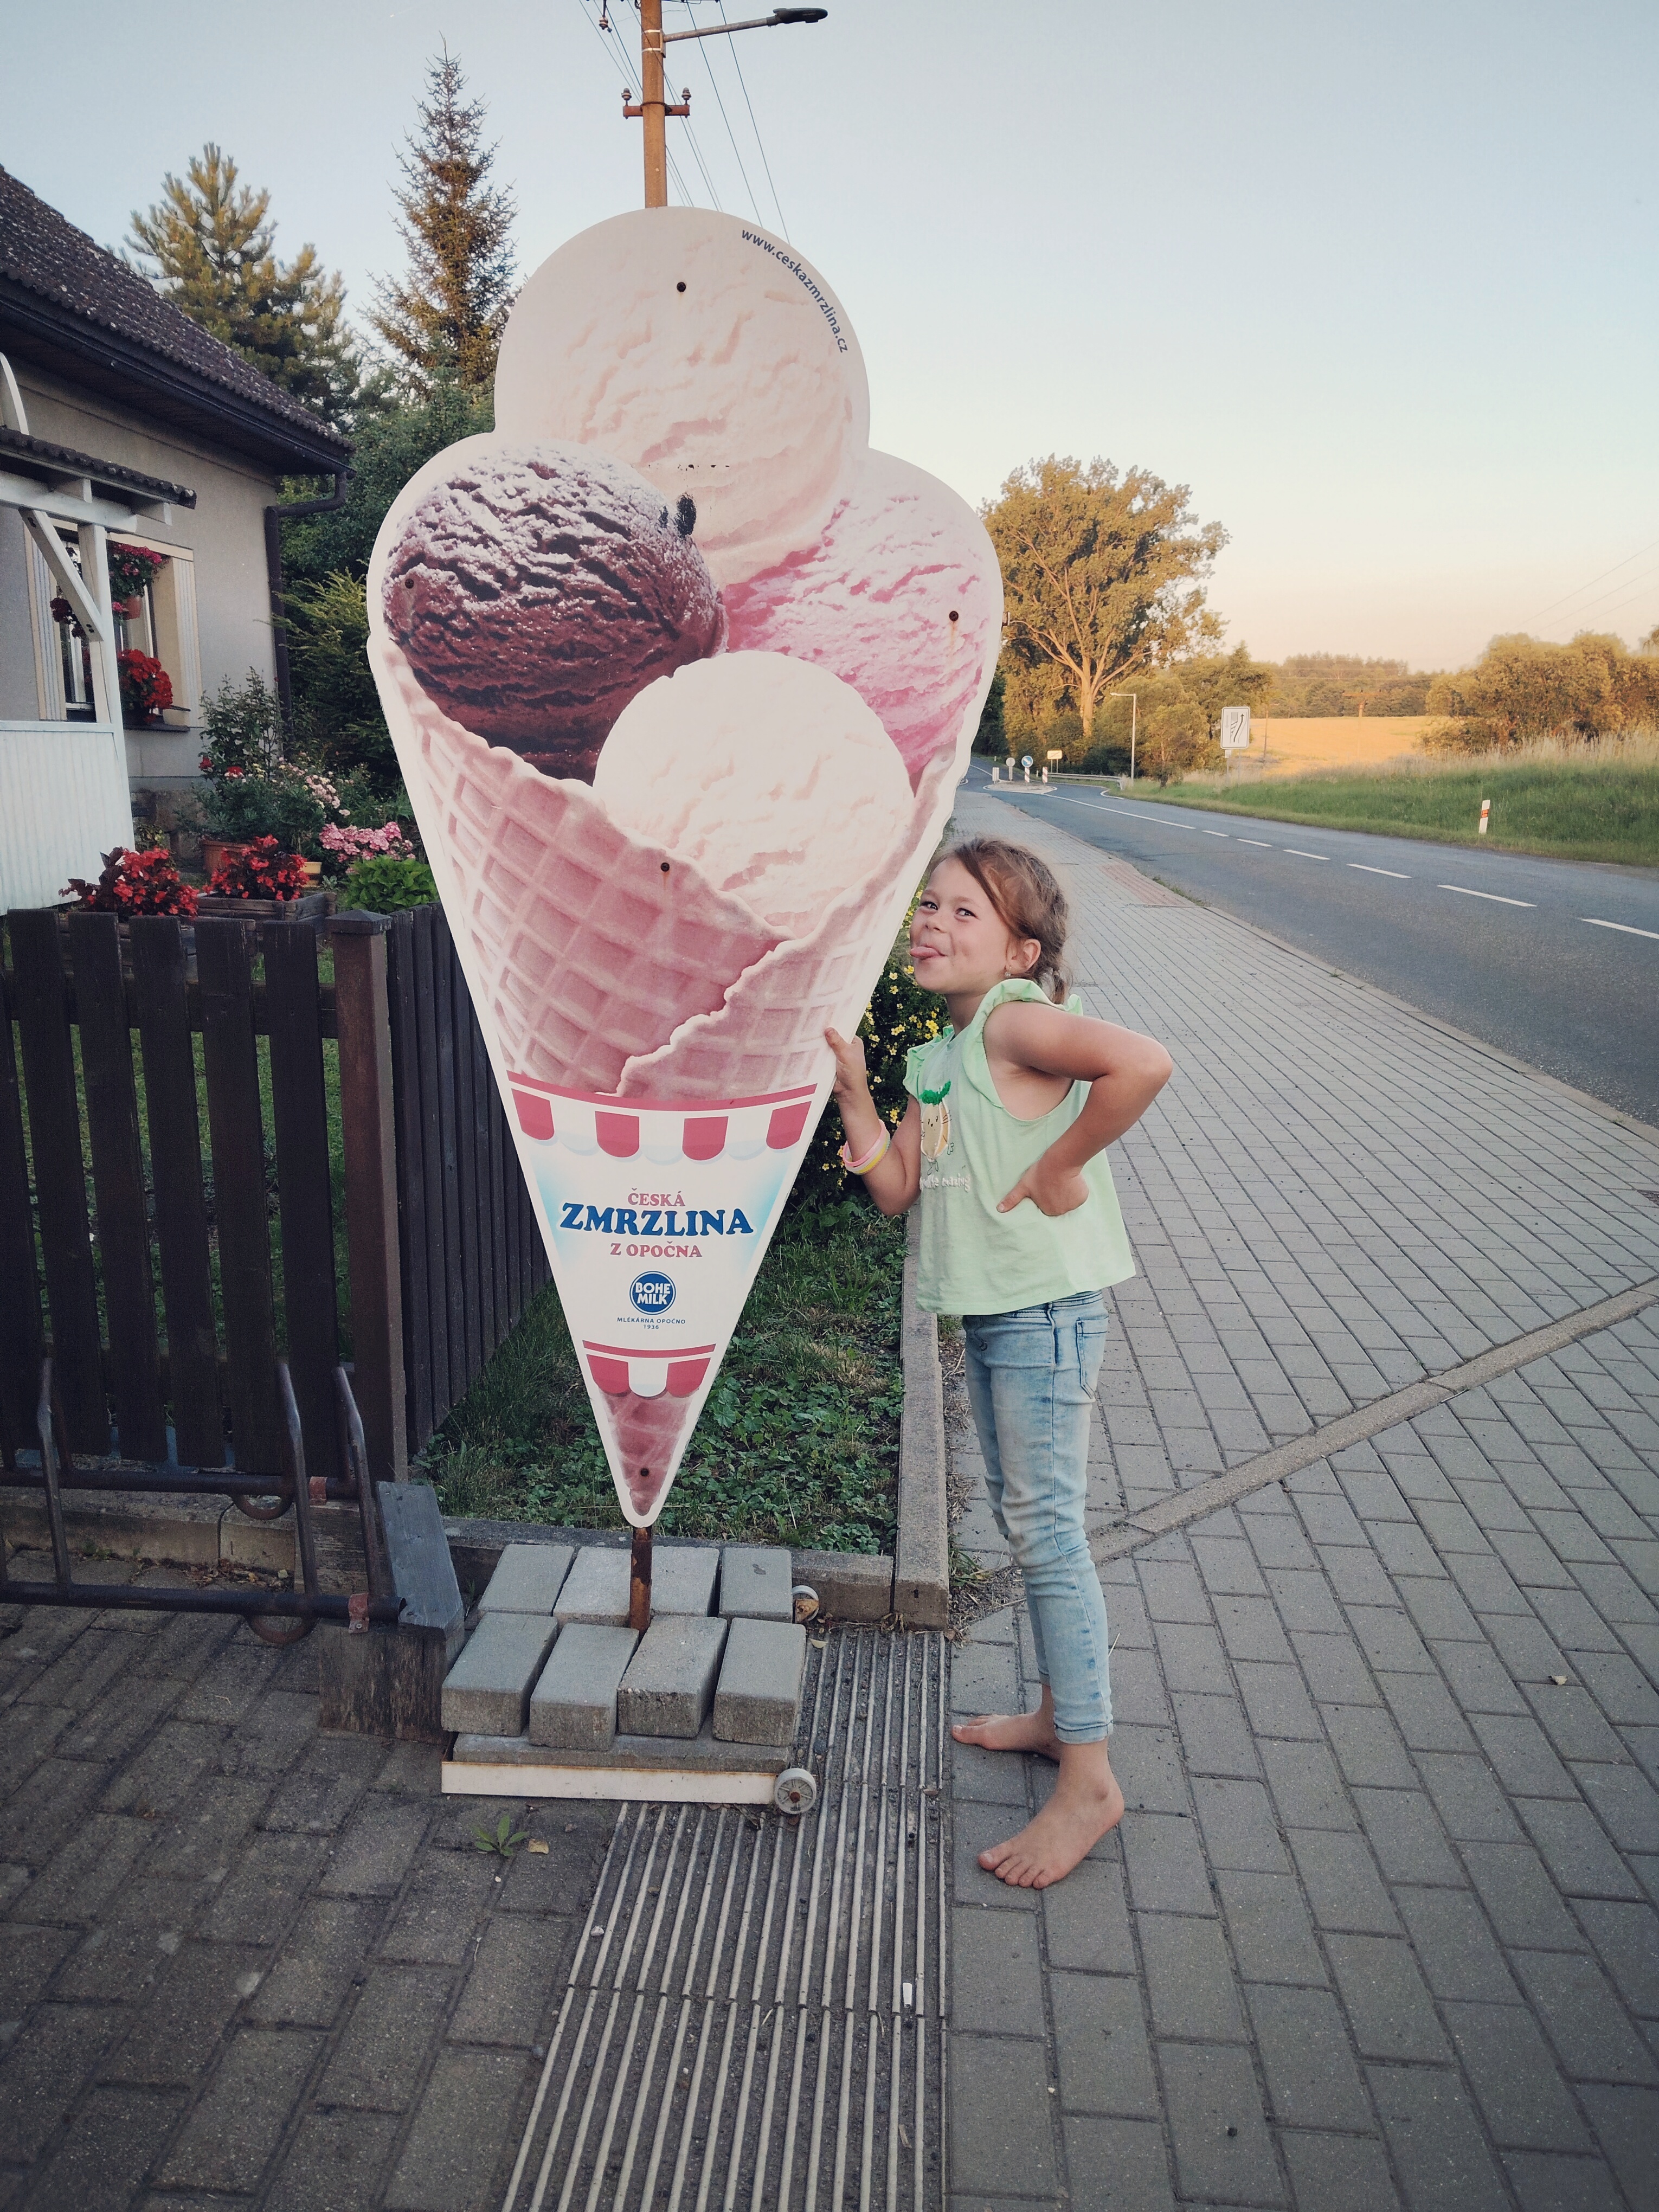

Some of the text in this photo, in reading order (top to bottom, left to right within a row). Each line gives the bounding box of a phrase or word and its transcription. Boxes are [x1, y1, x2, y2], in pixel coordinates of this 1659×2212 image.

[742, 229, 848, 353] www.ceskazmrzlina.cz
[628, 1187, 685, 1207] ČESKÁ
[560, 1202, 754, 1236] ZMRZLINA
[610, 1240, 703, 1258] Z OPOČNA
[635, 1282, 671, 1294] BOHE
[636, 1293, 668, 1305] MILK
